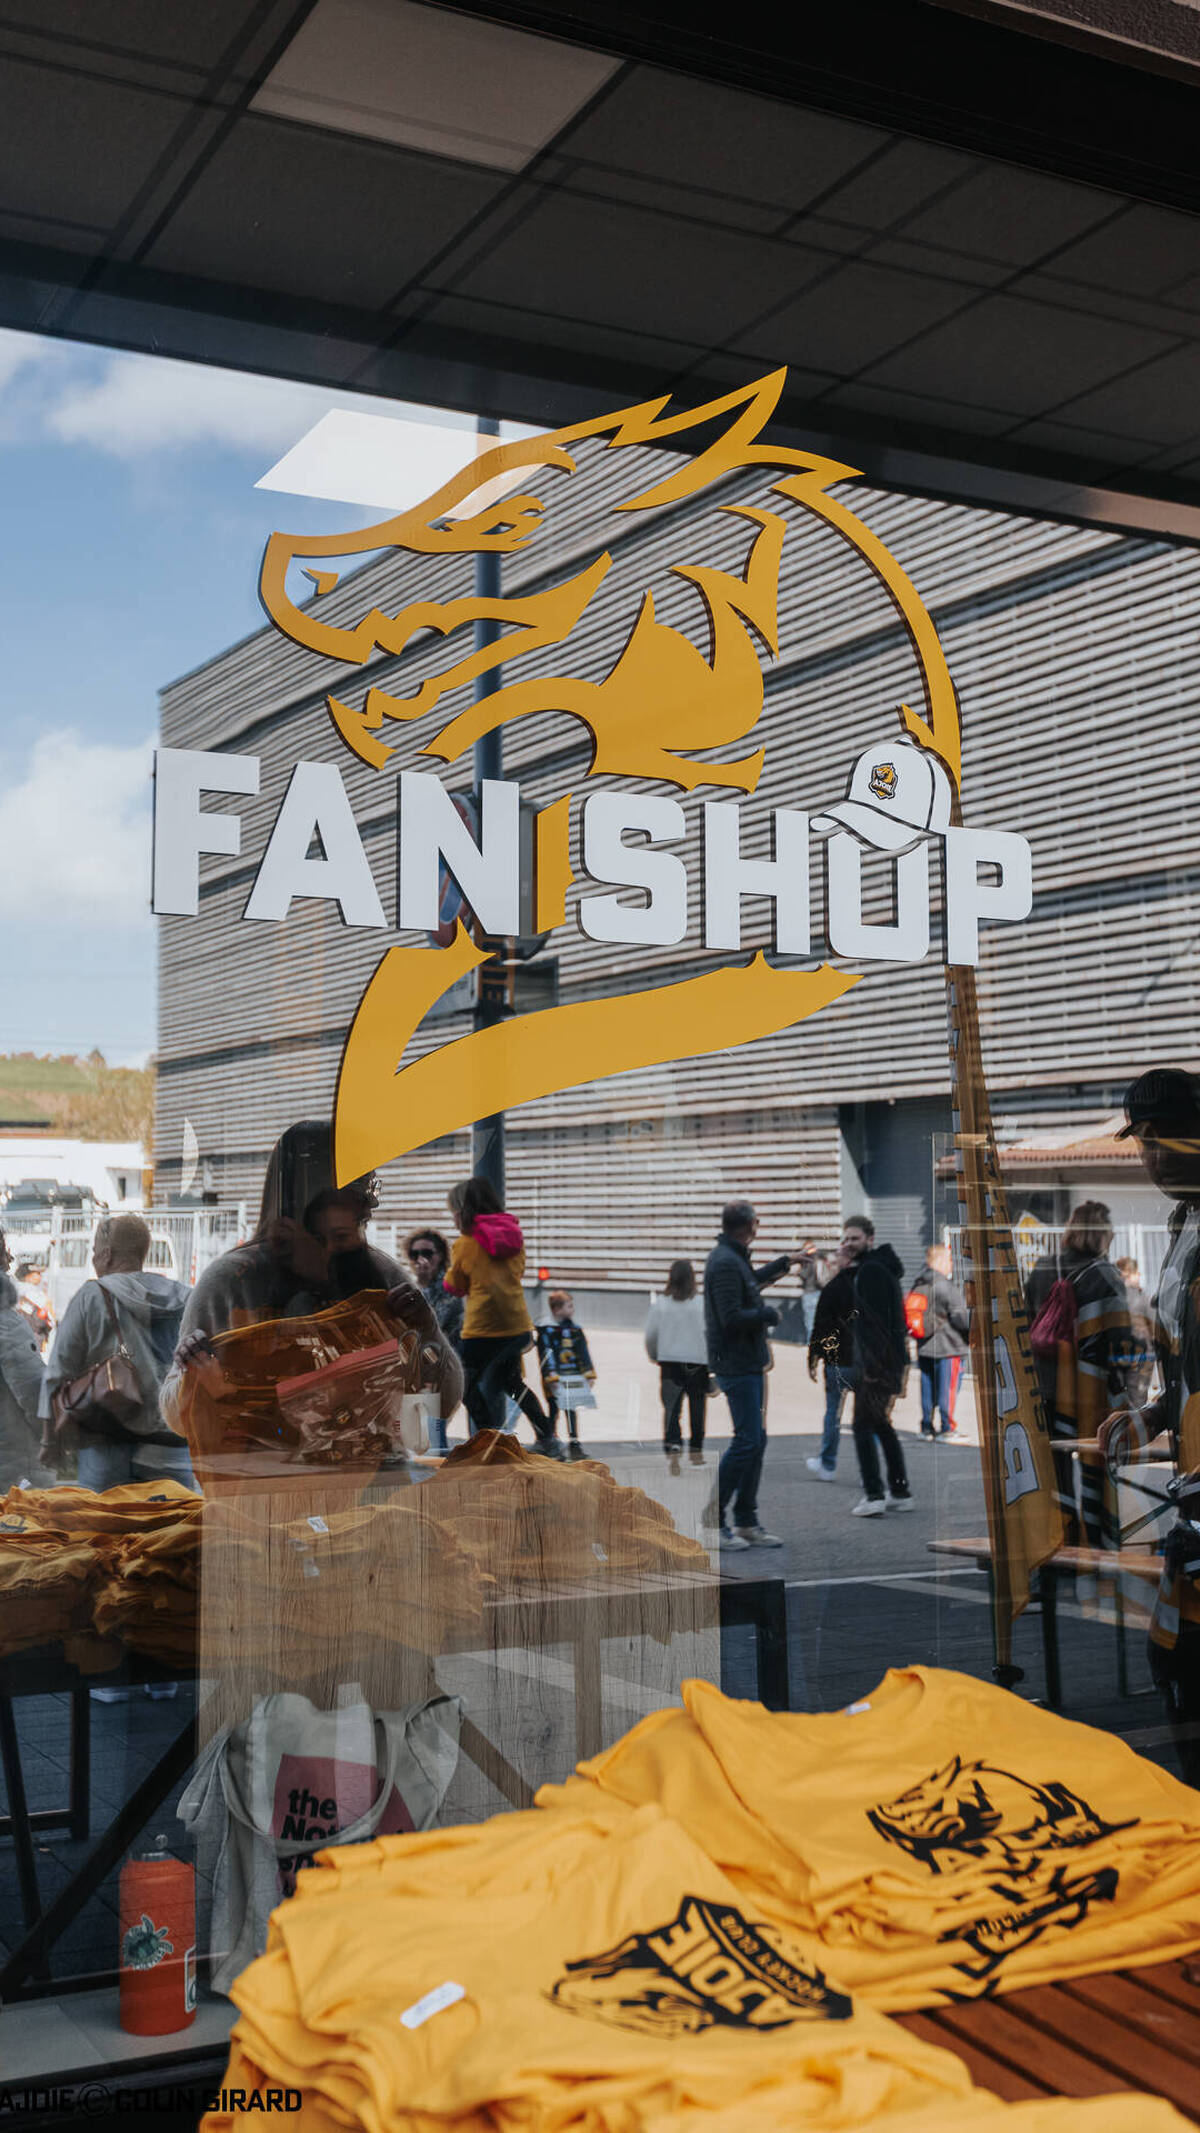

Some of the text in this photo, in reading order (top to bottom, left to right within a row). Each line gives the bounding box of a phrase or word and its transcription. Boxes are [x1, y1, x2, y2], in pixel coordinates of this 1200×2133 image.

[152, 747, 1033, 966] FAN SHOP
[288, 1788, 338, 1820] the
[647, 1901, 822, 2022] AJOIE
